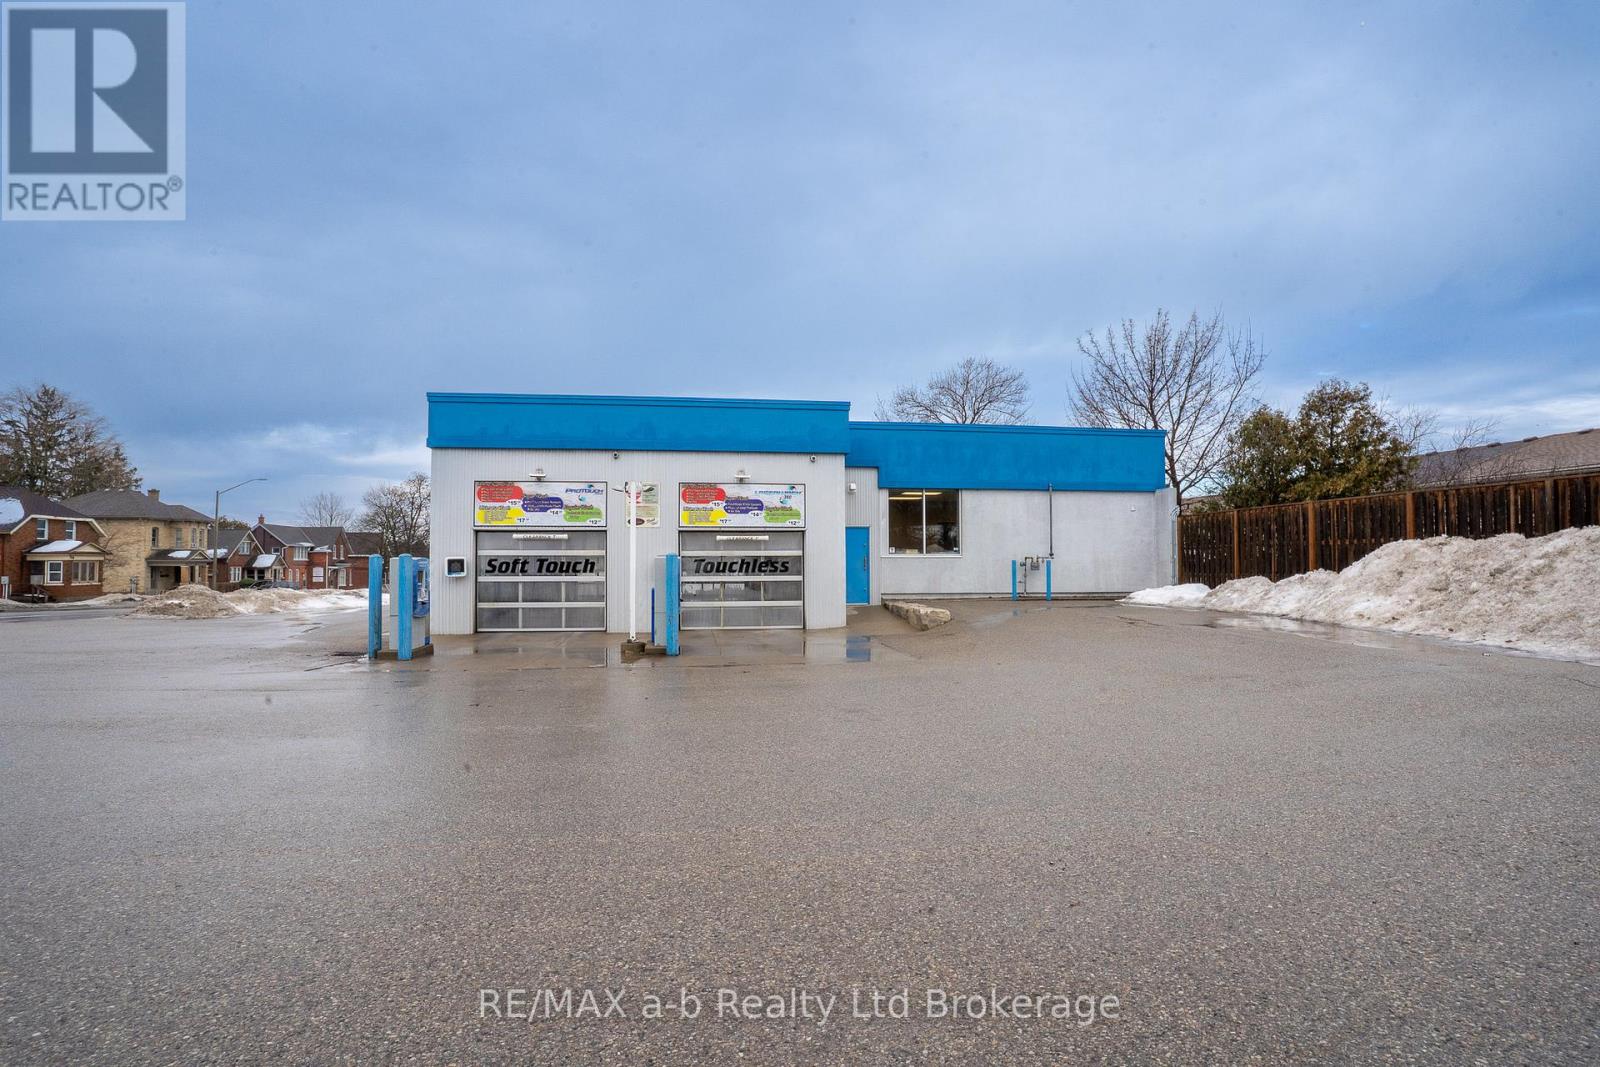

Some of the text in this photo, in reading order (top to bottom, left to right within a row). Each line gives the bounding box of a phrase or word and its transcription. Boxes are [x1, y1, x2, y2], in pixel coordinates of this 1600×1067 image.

[485, 558, 596, 574] Soft Touch
[693, 558, 790, 574] Touchless
